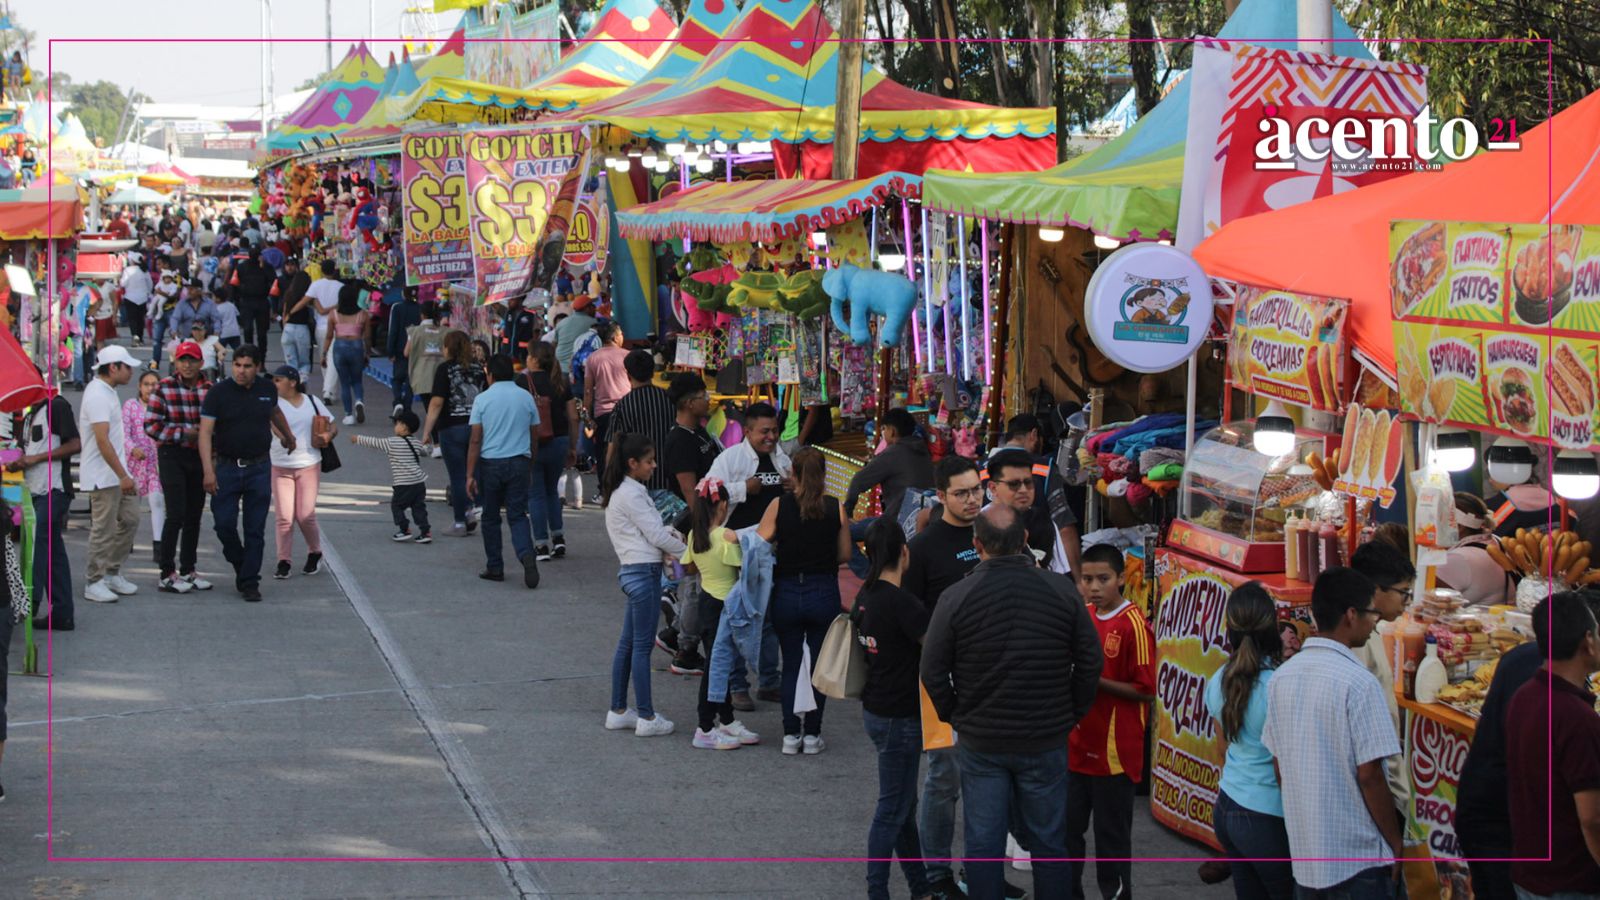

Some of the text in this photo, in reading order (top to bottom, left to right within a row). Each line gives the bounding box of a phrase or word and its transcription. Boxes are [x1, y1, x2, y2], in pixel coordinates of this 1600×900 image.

[406, 135, 463, 159] GOT
[411, 231, 430, 243] LA
[480, 243, 505, 258] LA
[1454, 236, 1500, 265] PLATANOS
[1450, 276, 1499, 304] FRITOS
[1573, 260, 1600, 297] BON
[1249, 298, 1313, 338] BANDERILLAS
[1251, 339, 1305, 371] COREANAS
[1553, 415, 1591, 443] HOT DOG
[1157, 579, 1232, 653] BANDERIL
[1174, 752, 1219, 794] MORDIDA
[1180, 792, 1187, 815] A
[1188, 796, 1214, 828] COR
